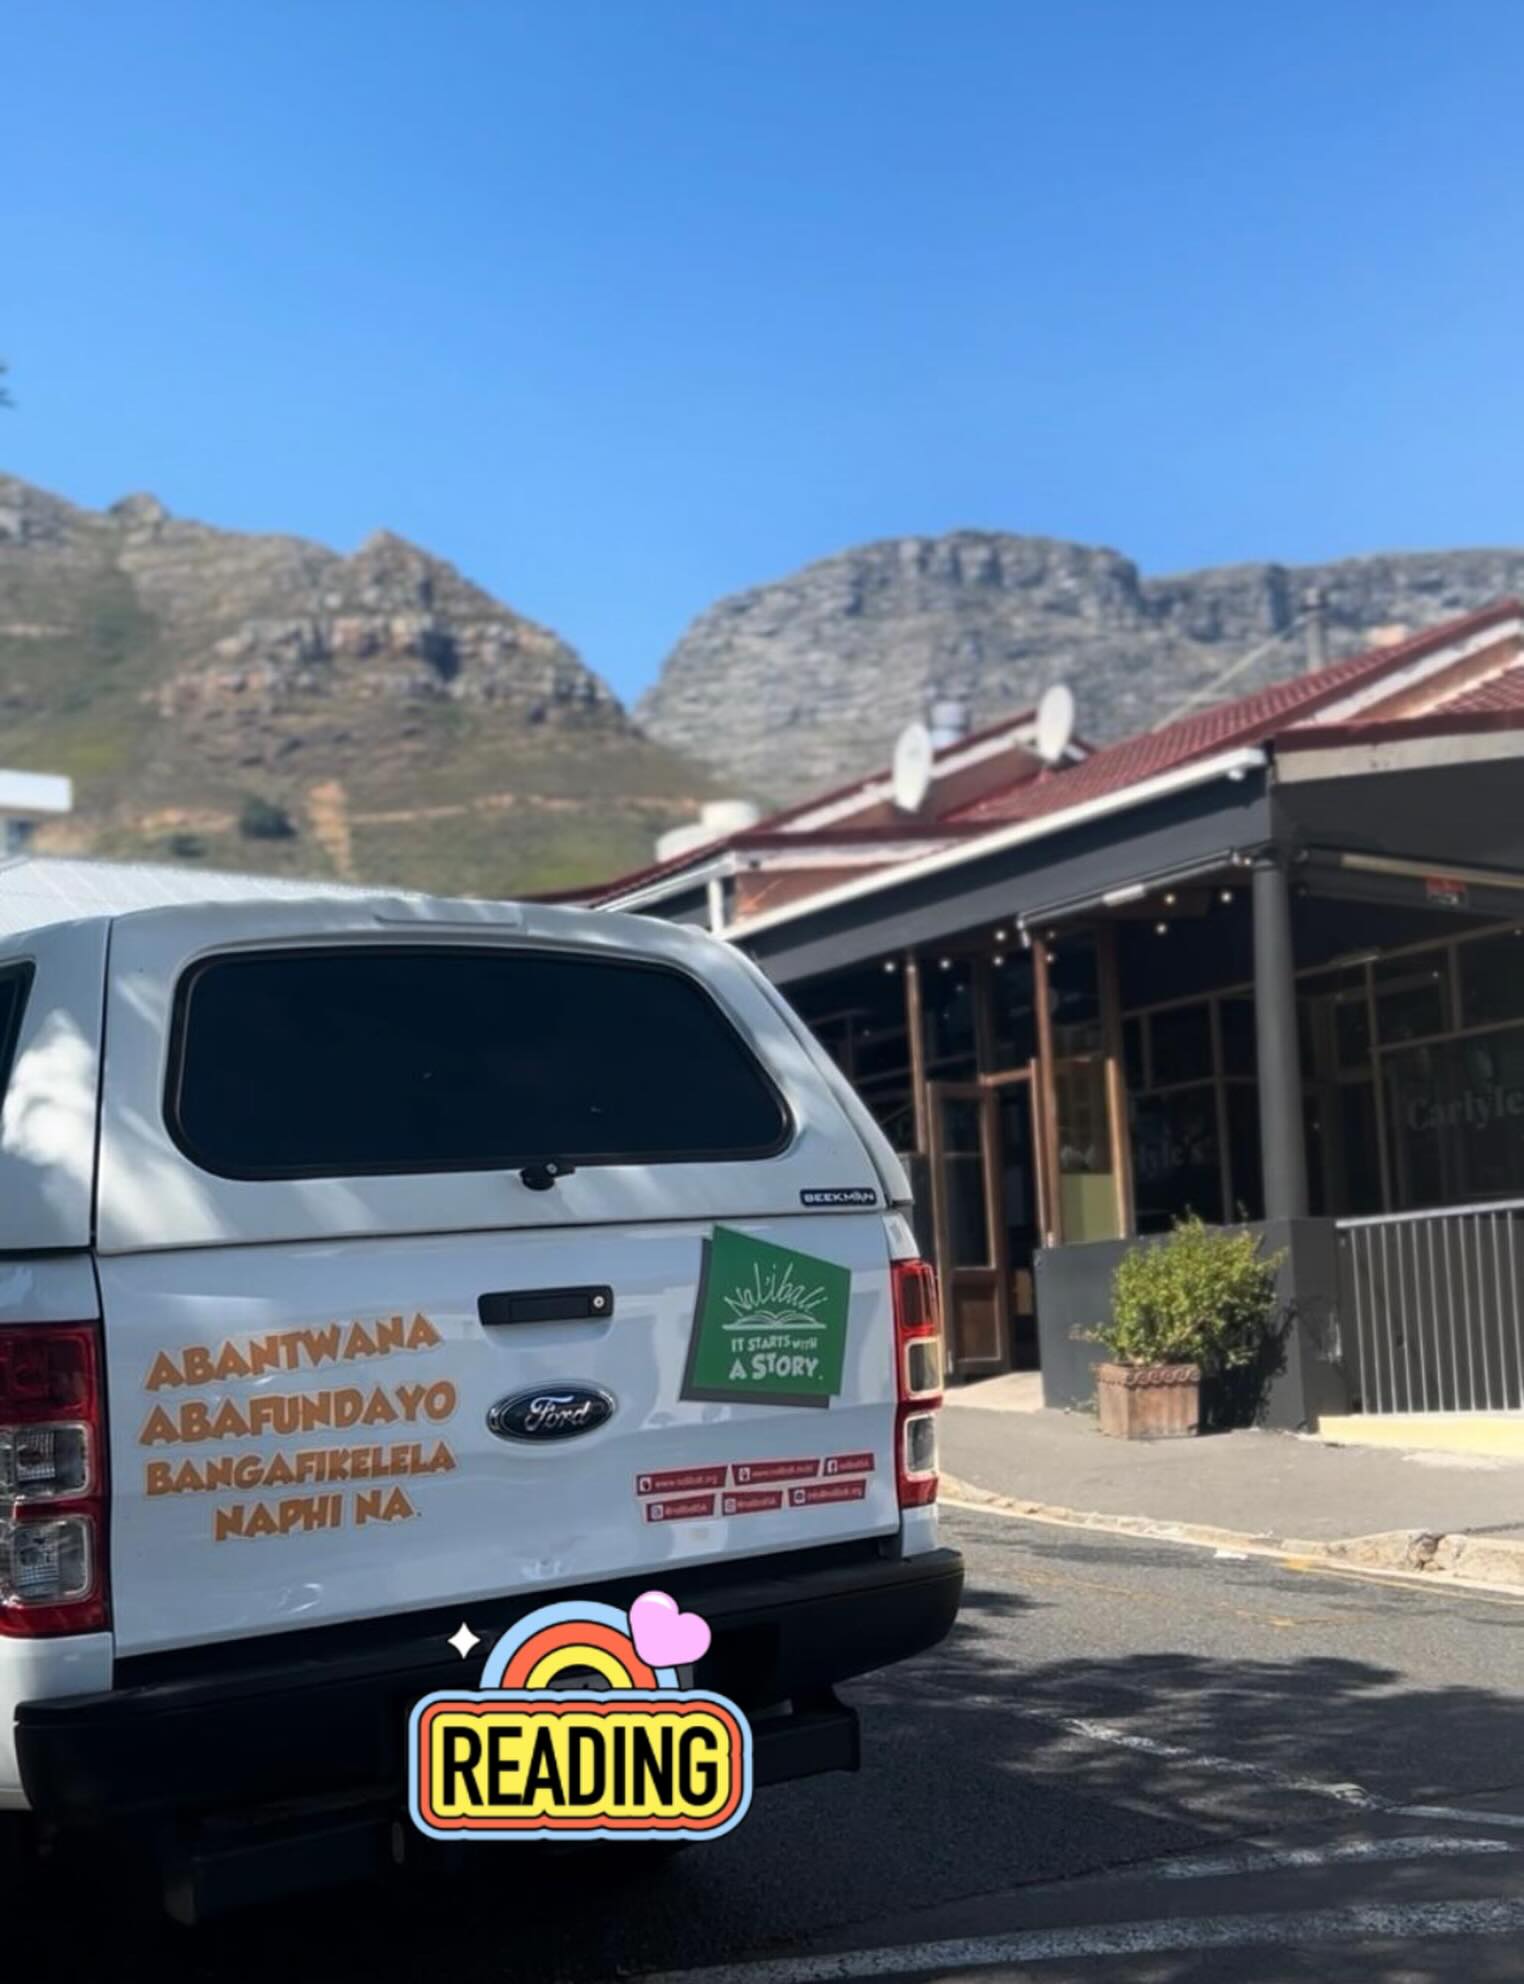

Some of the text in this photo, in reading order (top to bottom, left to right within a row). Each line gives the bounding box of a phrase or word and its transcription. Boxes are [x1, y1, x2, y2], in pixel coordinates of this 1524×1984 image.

[803, 1191, 875, 1203] BEEKMAN
[145, 1313, 442, 1392] ABANTWANA
[731, 1337, 745, 1353] IT
[747, 1334, 790, 1352] STARTS
[728, 1360, 747, 1381] A
[139, 1381, 458, 1446] ABAFUNDAYO
[524, 1395, 591, 1432] Ford
[145, 1440, 457, 1496] BANGAFIKELELA
[214, 1494, 344, 1542] NAPHI
